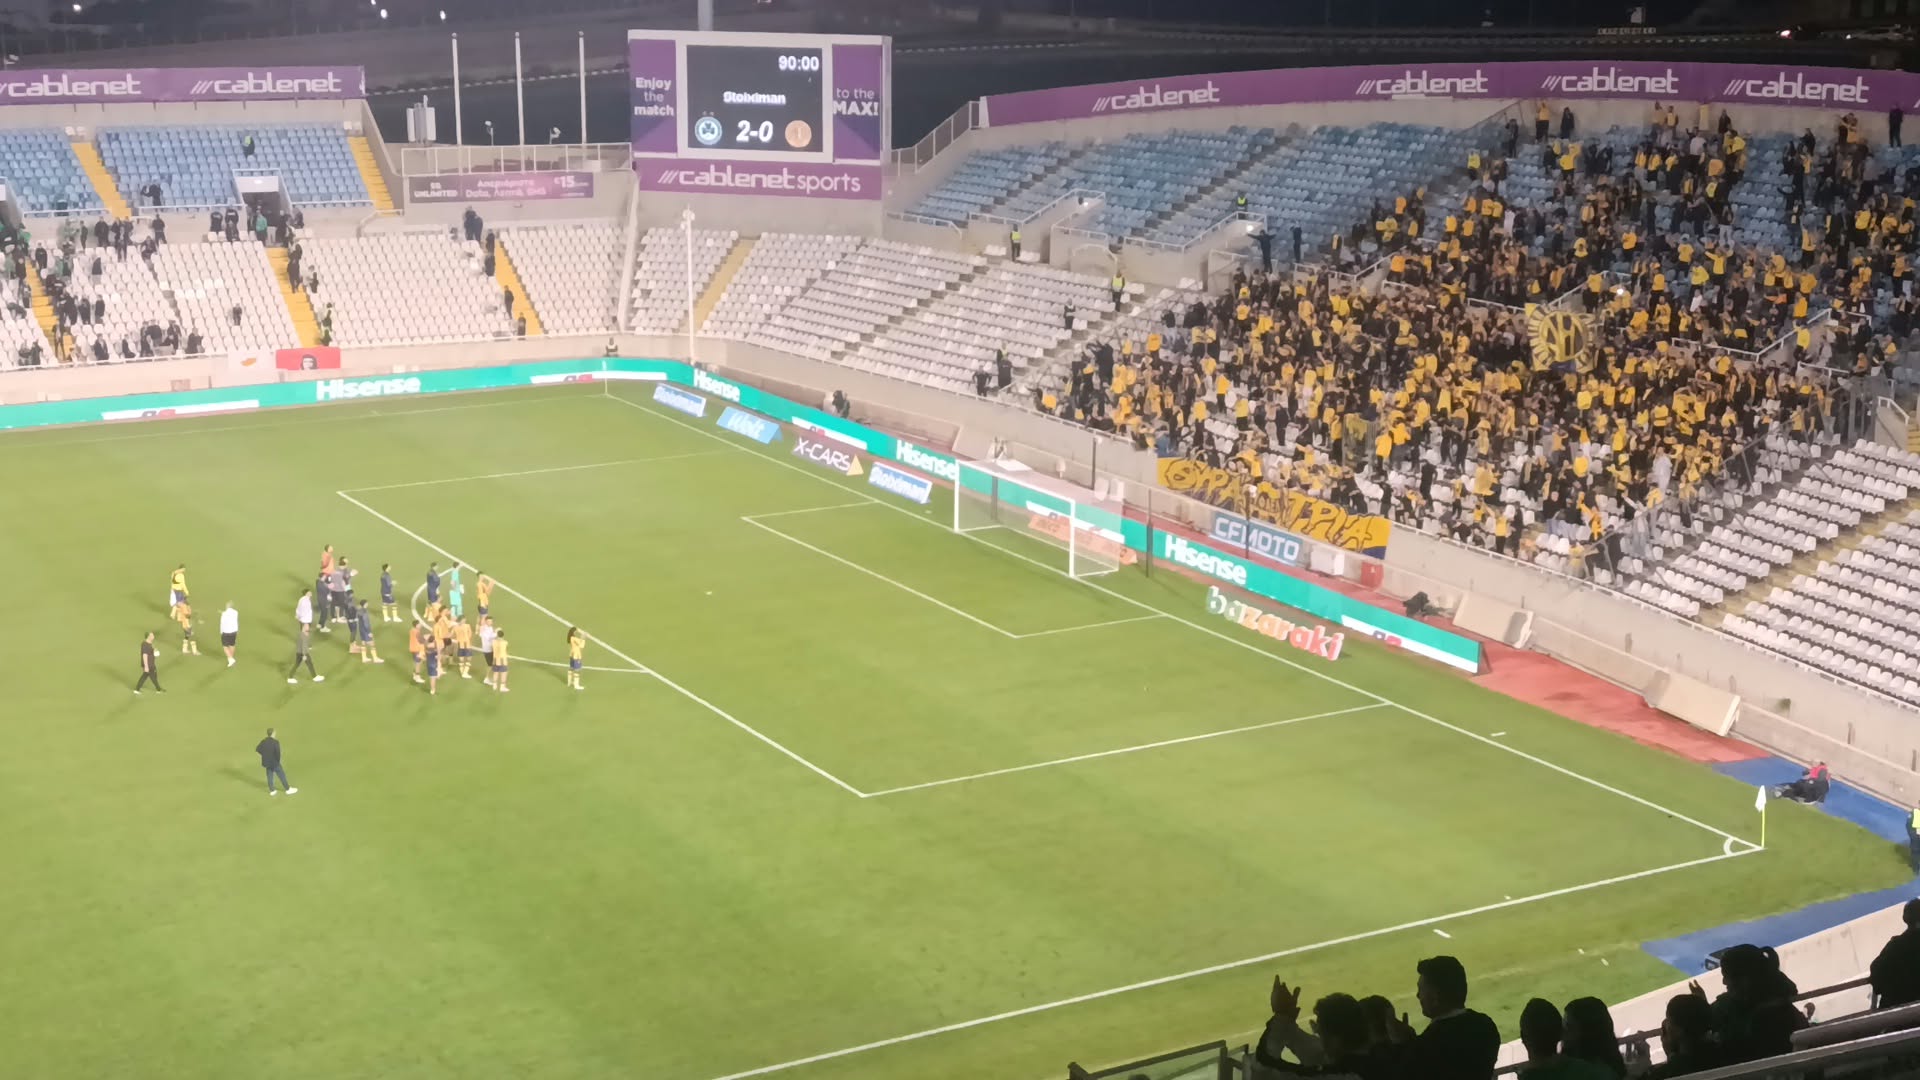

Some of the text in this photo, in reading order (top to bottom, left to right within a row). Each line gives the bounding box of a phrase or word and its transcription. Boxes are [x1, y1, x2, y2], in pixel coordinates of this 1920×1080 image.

[778, 55, 820, 71] 90:00
[8, 73, 142, 97] cablenet
[213, 71, 342, 94] cablenet
[635, 77, 672, 91] Enjoy
[1376, 70, 1489, 95] cablenet
[1561, 67, 1679, 94] cablenet
[1745, 71, 1870, 103] cablenet
[644, 92, 665, 102] the
[836, 88, 875, 100] to the
[1111, 80, 1220, 110] cablenet
[634, 105, 675, 117] match
[832, 100, 880, 117] MAX!
[735, 119, 774, 143] 2-0
[316, 376, 421, 401] Hisense
[693, 368, 741, 402] Hisense
[793, 436, 851, 472] X-CARS
[896, 439, 959, 481] Hisense
[1214, 517, 1300, 562] CFMOTO
[1165, 534, 1247, 585] Hisense
[1205, 585, 1344, 661] bazaraki
